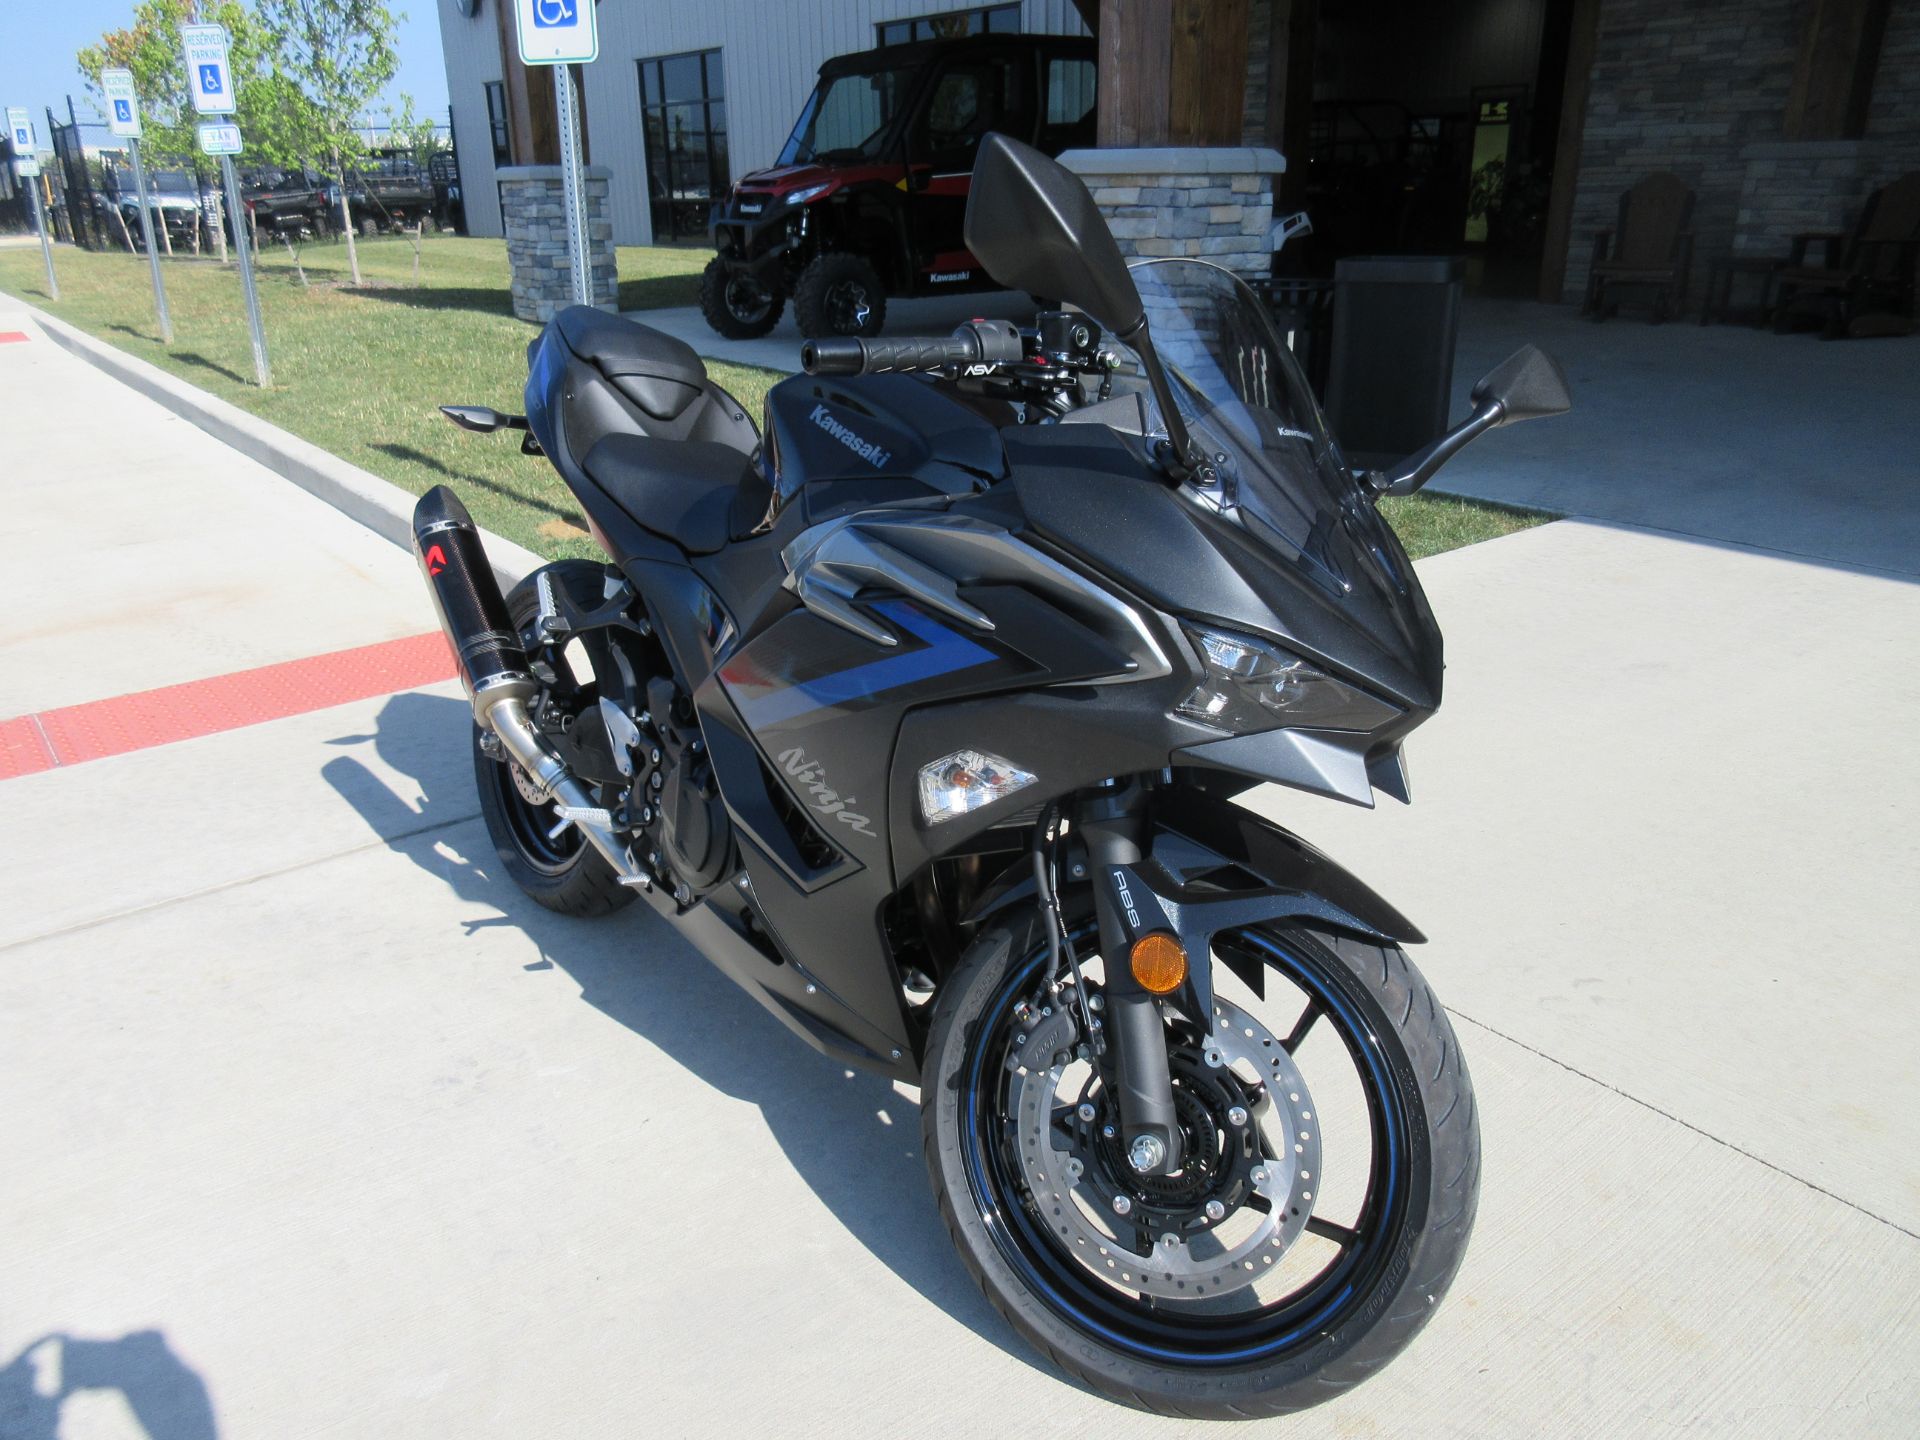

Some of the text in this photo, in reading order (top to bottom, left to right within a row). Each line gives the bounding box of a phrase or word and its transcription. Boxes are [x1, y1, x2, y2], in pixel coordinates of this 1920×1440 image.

[187, 34, 222, 46] RESERVED
[191, 49, 223, 60] PARKING
[930, 271, 970, 283] Kawasaki
[964, 364, 997, 376] ASV
[809, 403, 892, 469] Kawasaki
[778, 746, 877, 837] Ninja
[1113, 870, 1141, 928] ABS
